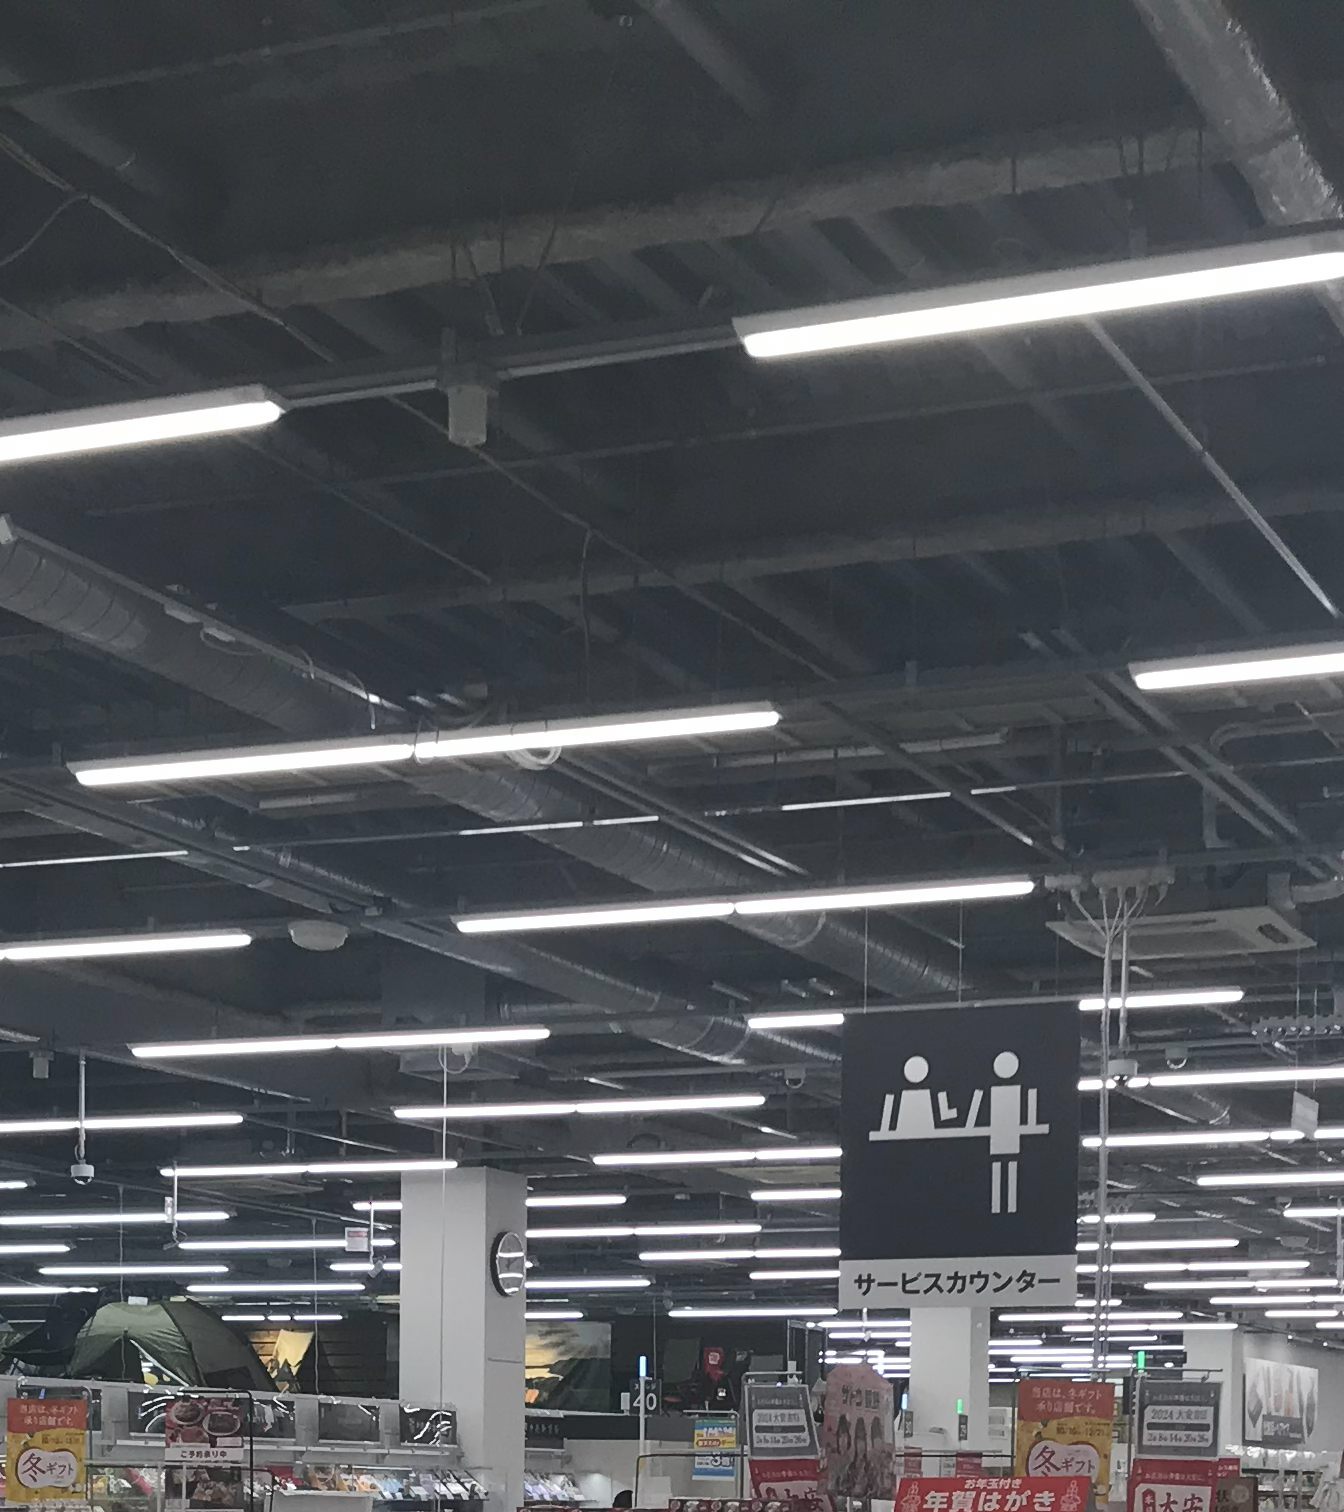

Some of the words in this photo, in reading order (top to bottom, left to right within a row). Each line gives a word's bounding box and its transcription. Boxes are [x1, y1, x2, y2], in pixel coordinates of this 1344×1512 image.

[854, 1270, 1060, 1296] サービスカウンター
[1151, 1409, 1173, 1420] 2024
[181, 1450, 227, 1459] ご予約承り中
[21, 1452, 74, 1483] 冬ギフト
[964, 1478, 1022, 1489] お年玉付き
[922, 1490, 1056, 1512] 年賀はがき
